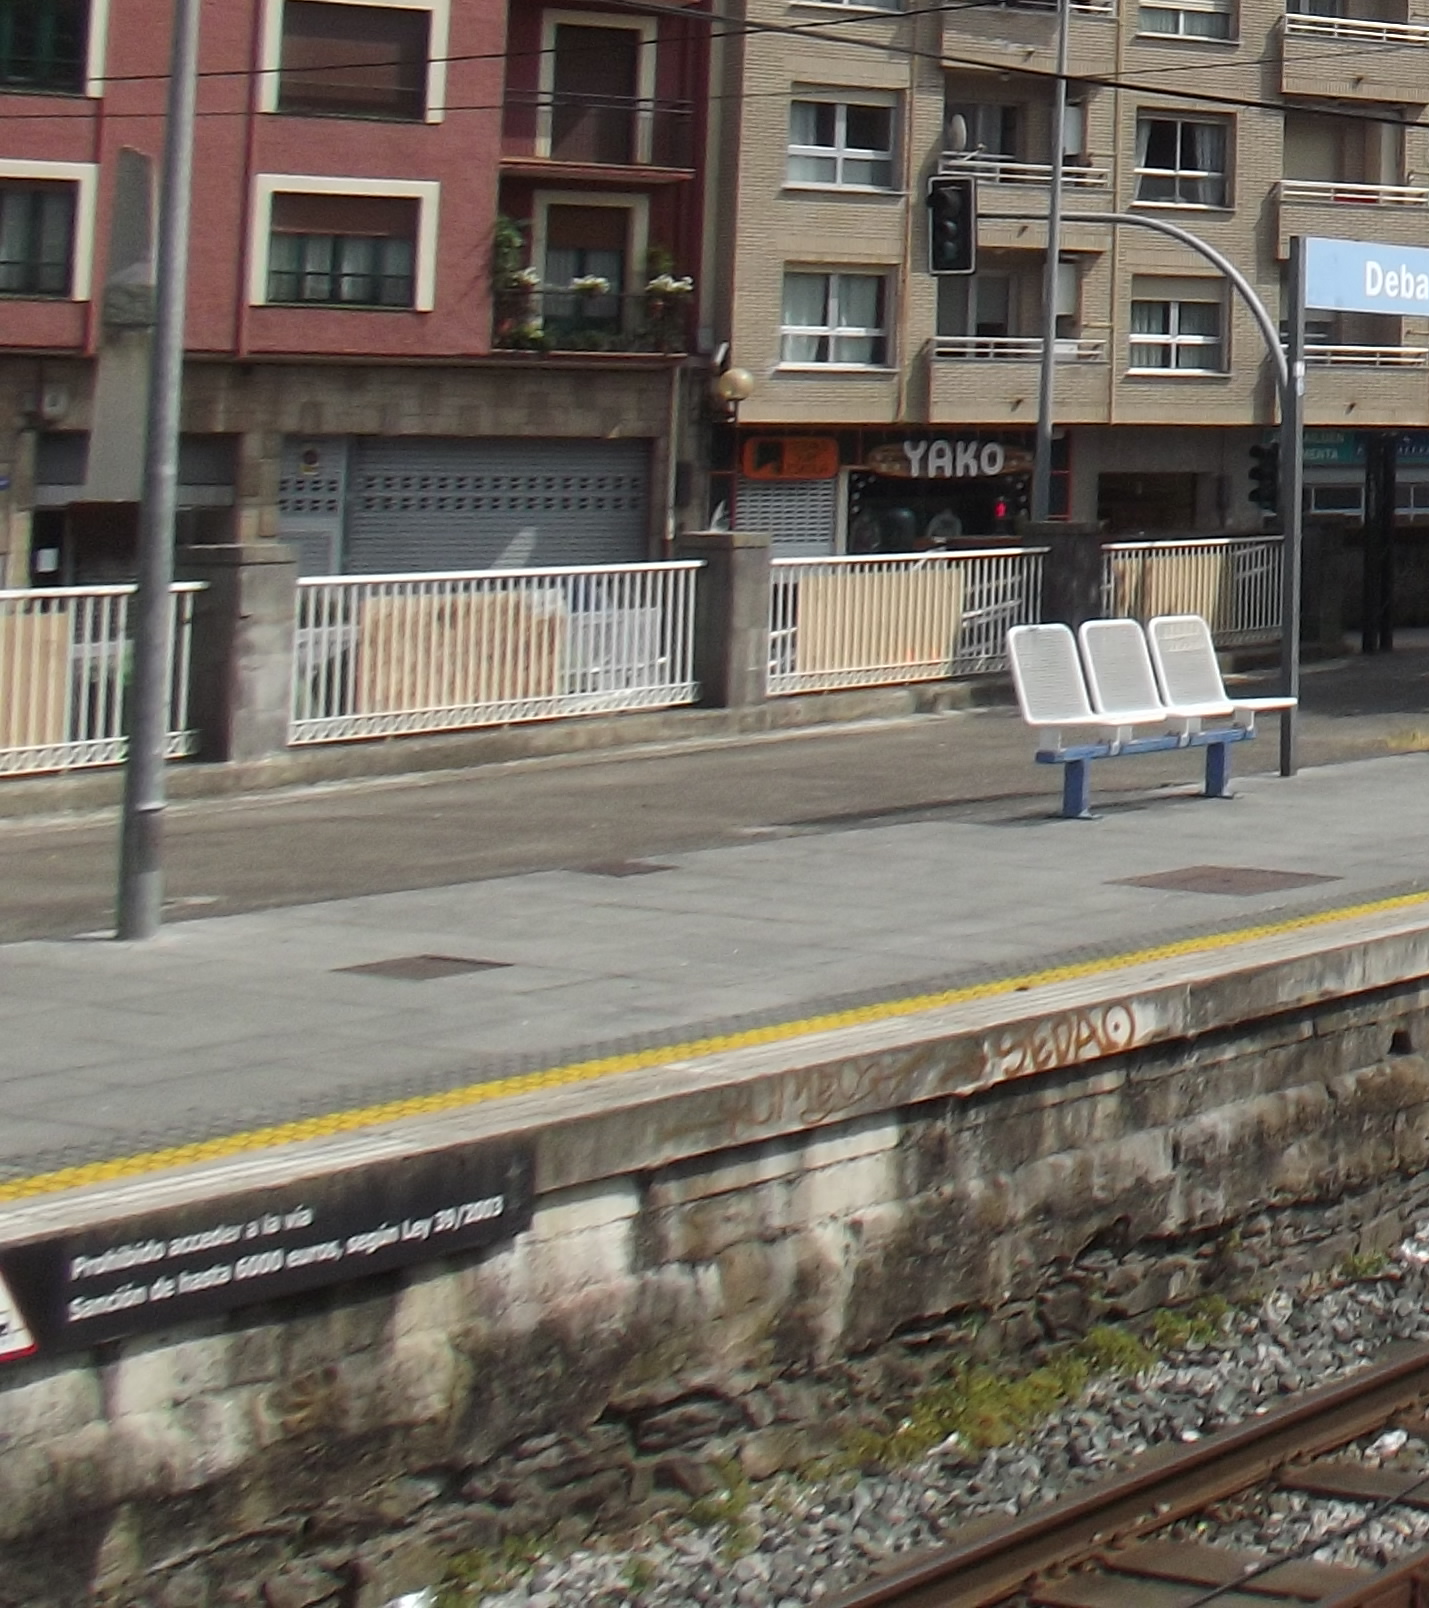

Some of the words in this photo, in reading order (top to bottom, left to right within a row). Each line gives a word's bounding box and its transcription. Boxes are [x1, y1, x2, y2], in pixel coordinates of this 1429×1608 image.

[1364, 260, 1429, 301] Deba
[903, 440, 1005, 478] YAKO
[67, 1280, 148, 1323] Sanción
[150, 1274, 176, 1302] de
[178, 1262, 232, 1295] hasta
[234, 1248, 284, 1280] 6000
[401, 1217, 434, 1241] Ley
[70, 1238, 167, 1282] Prohibido
[167, 1224, 244, 1258] acceder
[244, 1220, 260, 1240] a
[261, 1213, 282, 1236] la
